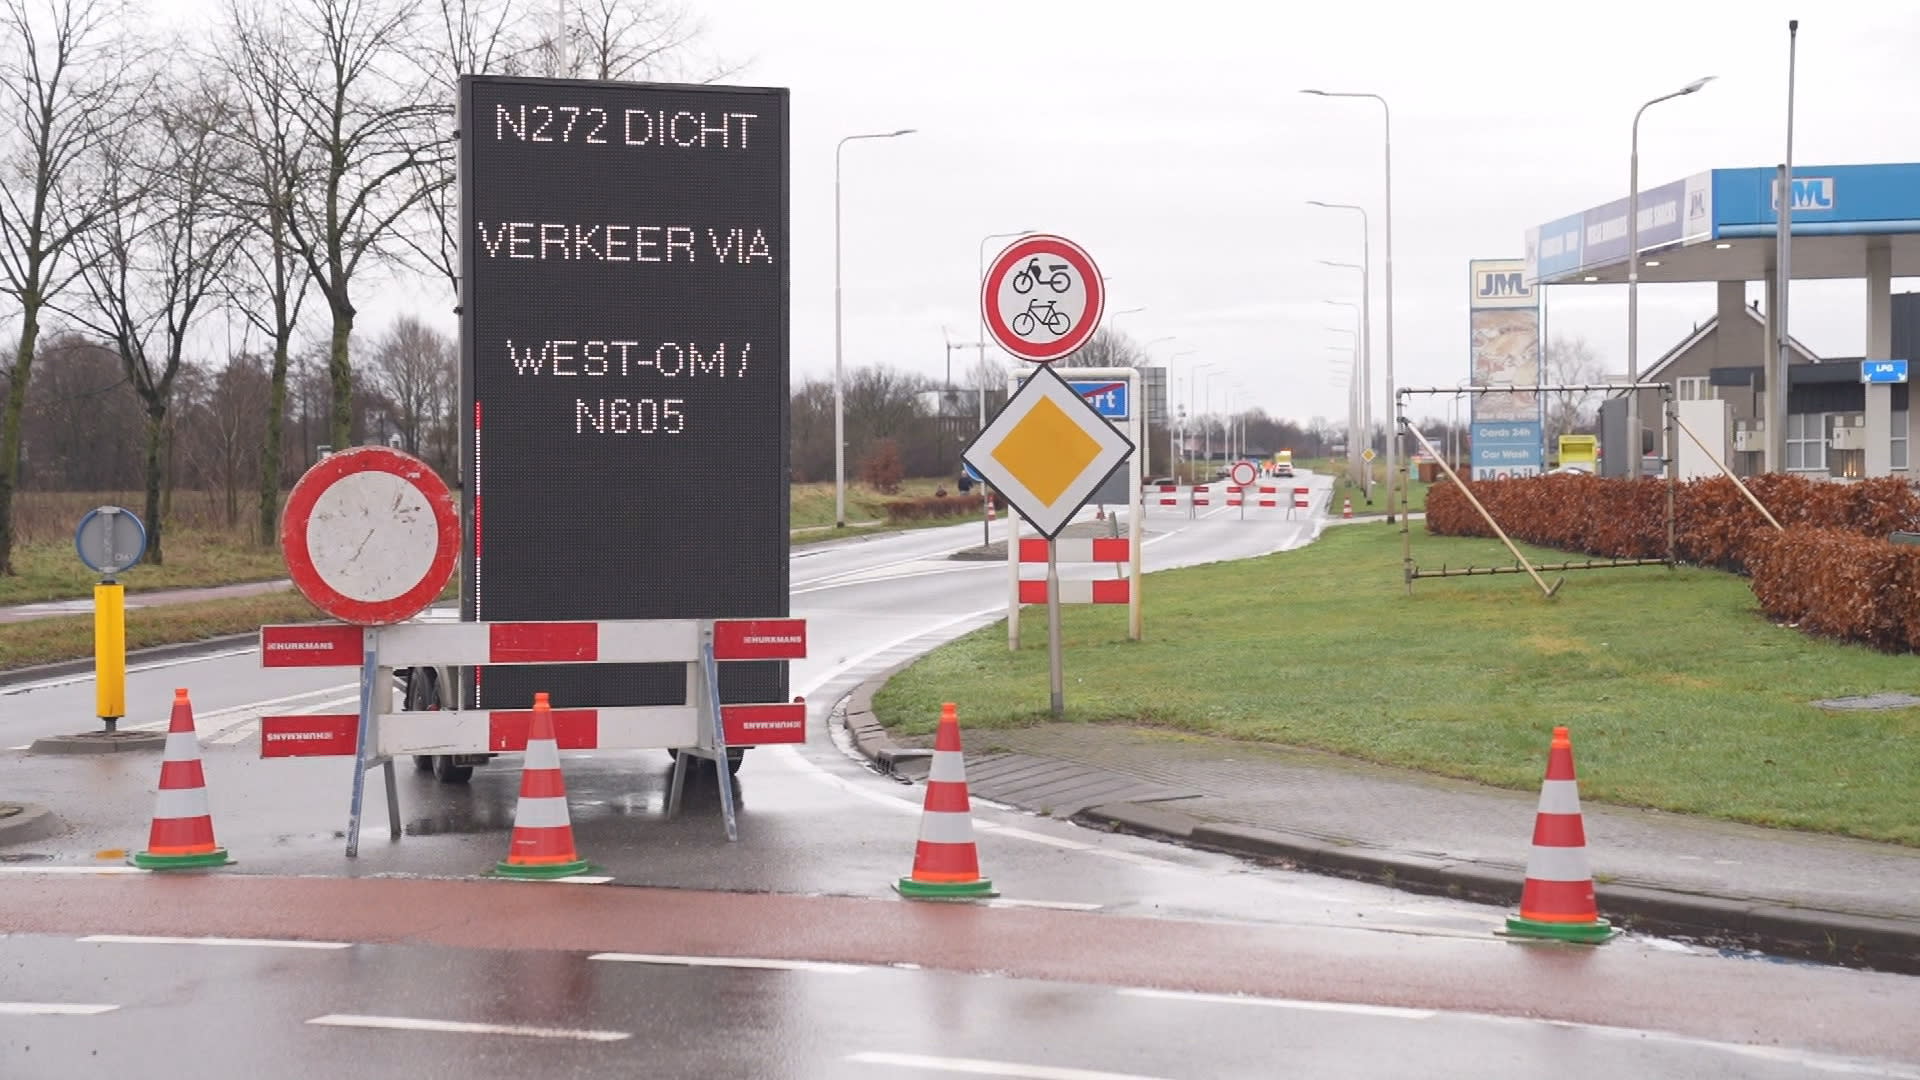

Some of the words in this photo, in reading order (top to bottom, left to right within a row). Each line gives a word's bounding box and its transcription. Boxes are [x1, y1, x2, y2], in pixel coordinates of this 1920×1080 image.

[496, 104, 608, 144] N272
[624, 109, 758, 149] DICHT
[477, 221, 695, 262] VERKEER
[707, 228, 773, 264] VIA
[1480, 272, 1529, 295] JML
[506, 339, 725, 378] WEST-OM
[1875, 363, 1894, 373] LPG
[576, 398, 684, 434] N605
[1479, 428, 1510, 438] Cards
[1512, 428, 1531, 438] 24h
[1481, 449, 1500, 459] Car
[1502, 449, 1530, 459] Wash
[276, 642, 334, 650] HURKMANS
[751, 635, 801, 643] HURKMANS
